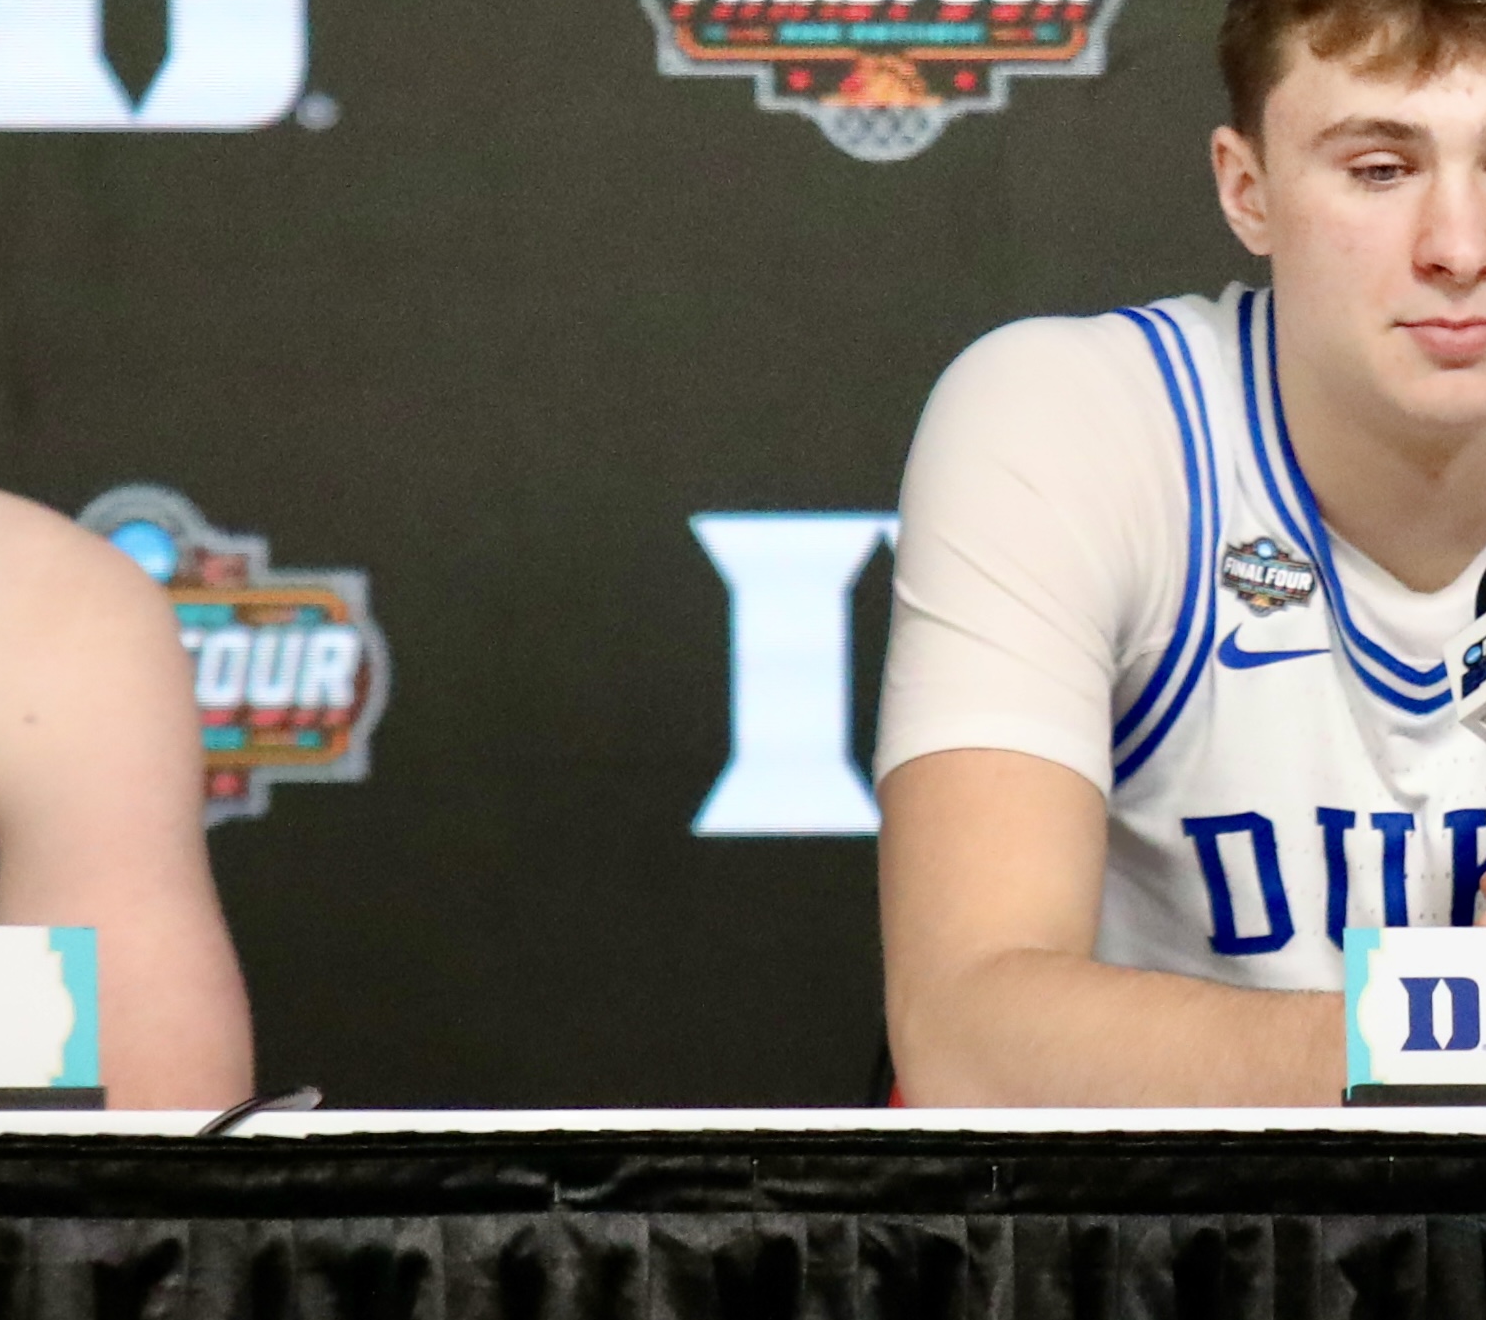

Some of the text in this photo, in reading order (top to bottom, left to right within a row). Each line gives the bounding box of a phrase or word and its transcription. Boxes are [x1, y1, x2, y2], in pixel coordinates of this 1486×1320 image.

[1224, 555, 1314, 592] FINAL FOUR
[1399, 976, 1481, 1051] D
